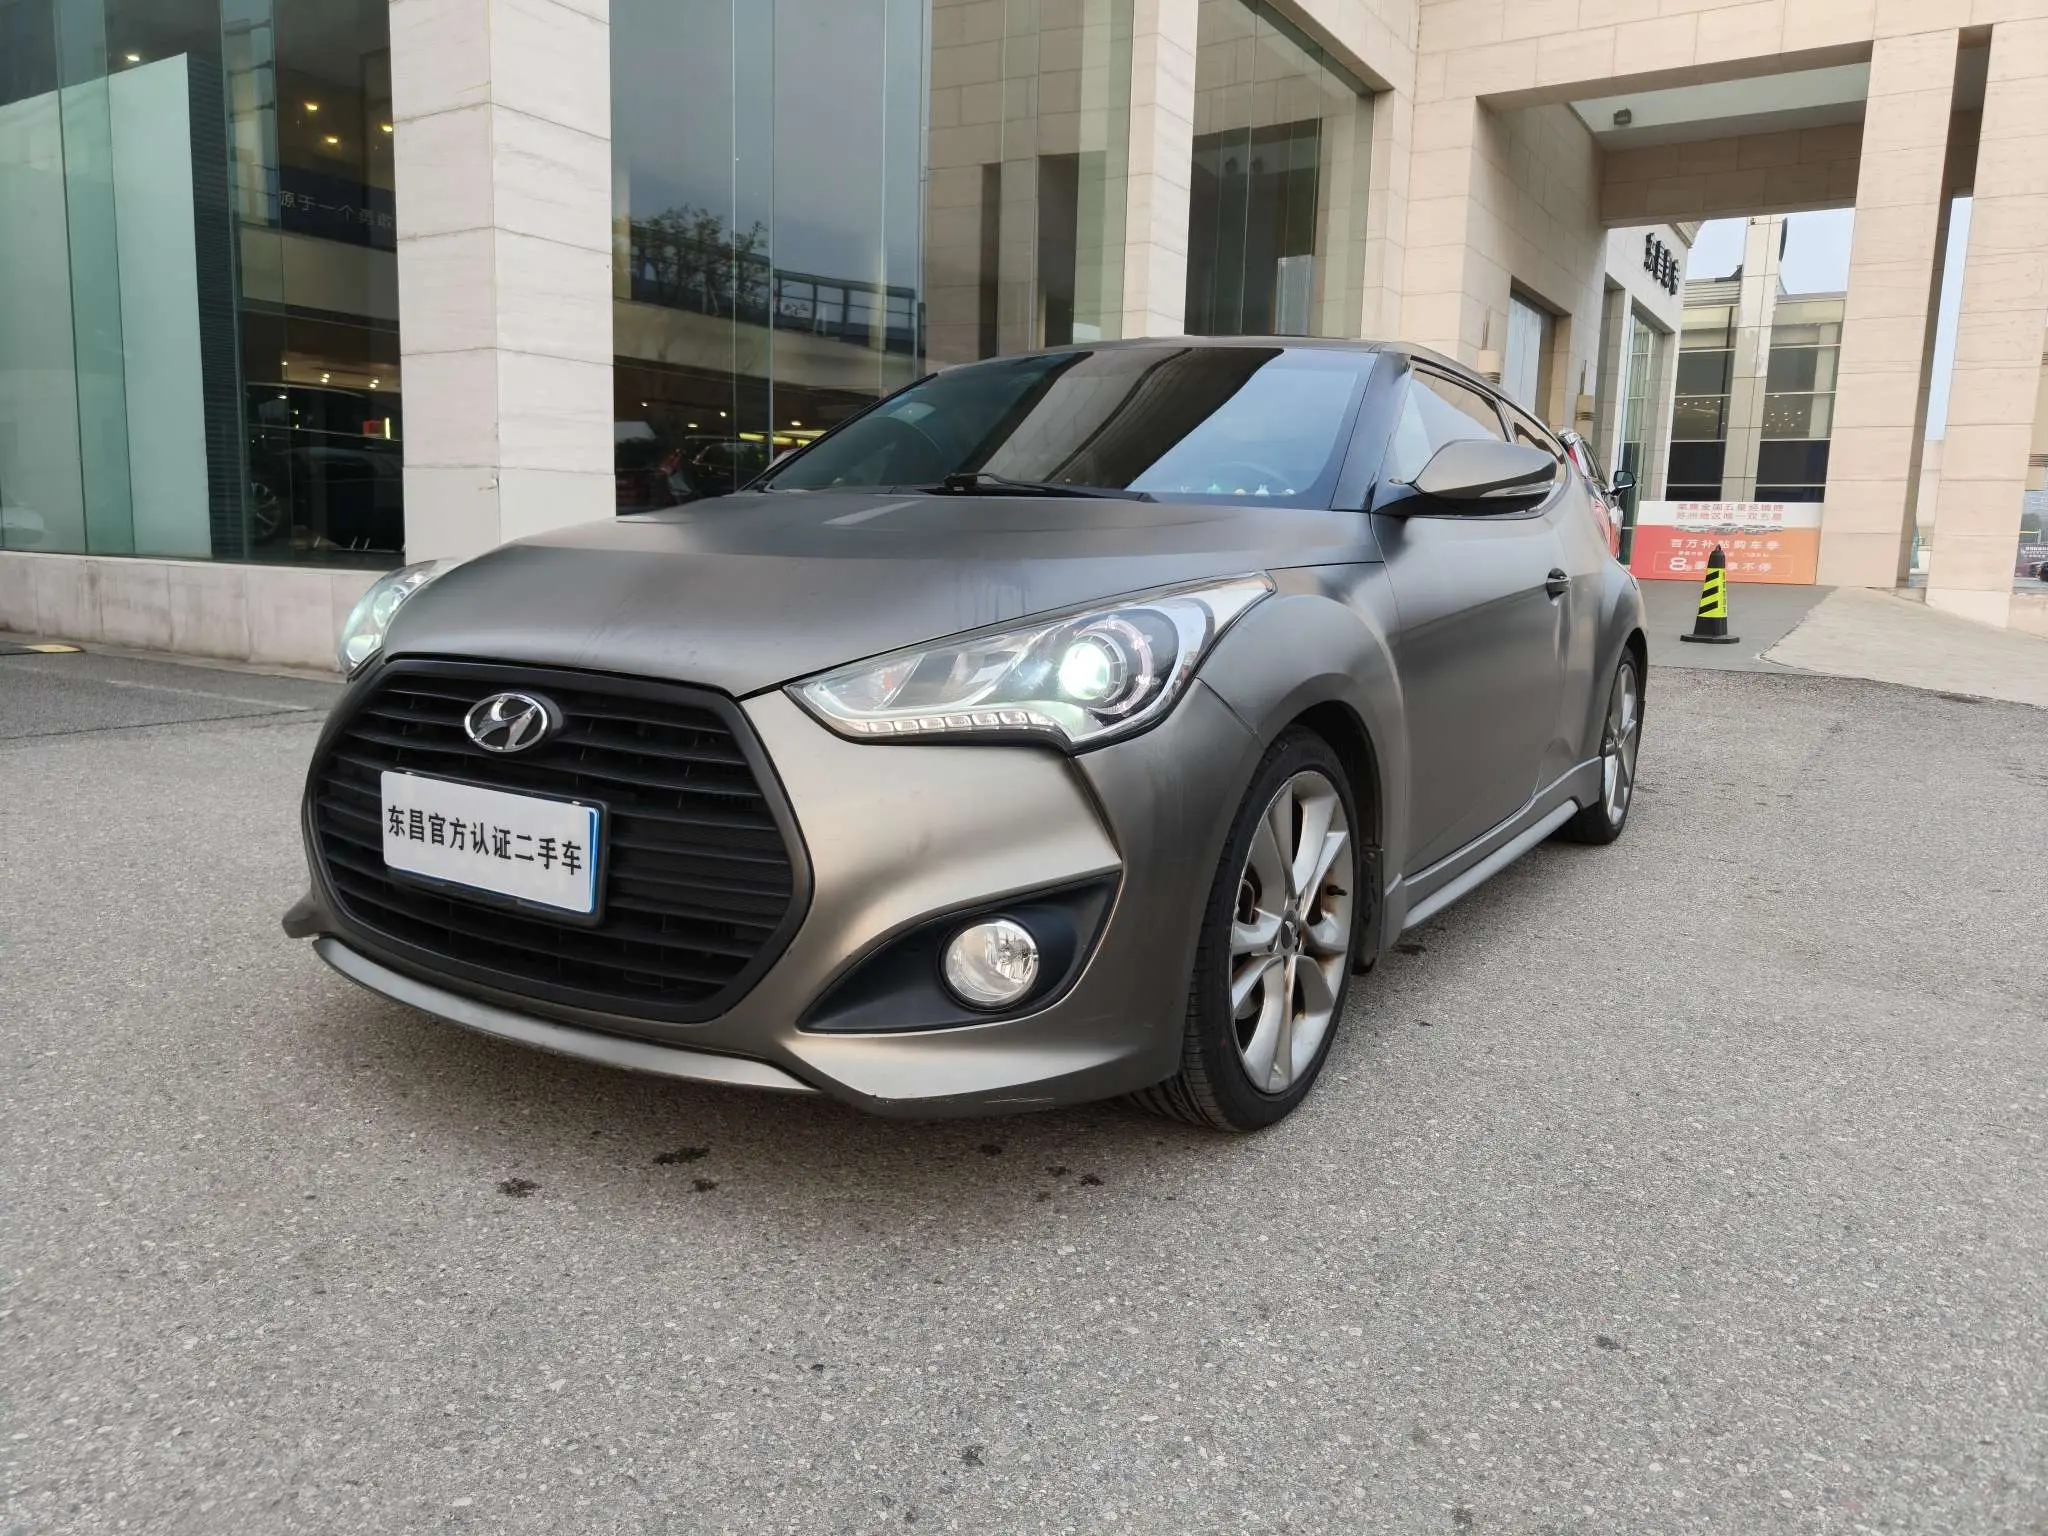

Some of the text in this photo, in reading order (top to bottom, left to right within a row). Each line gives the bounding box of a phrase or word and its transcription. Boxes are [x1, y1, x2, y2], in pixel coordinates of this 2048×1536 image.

[387, 804, 583, 876] 东昌官方认证二手车
